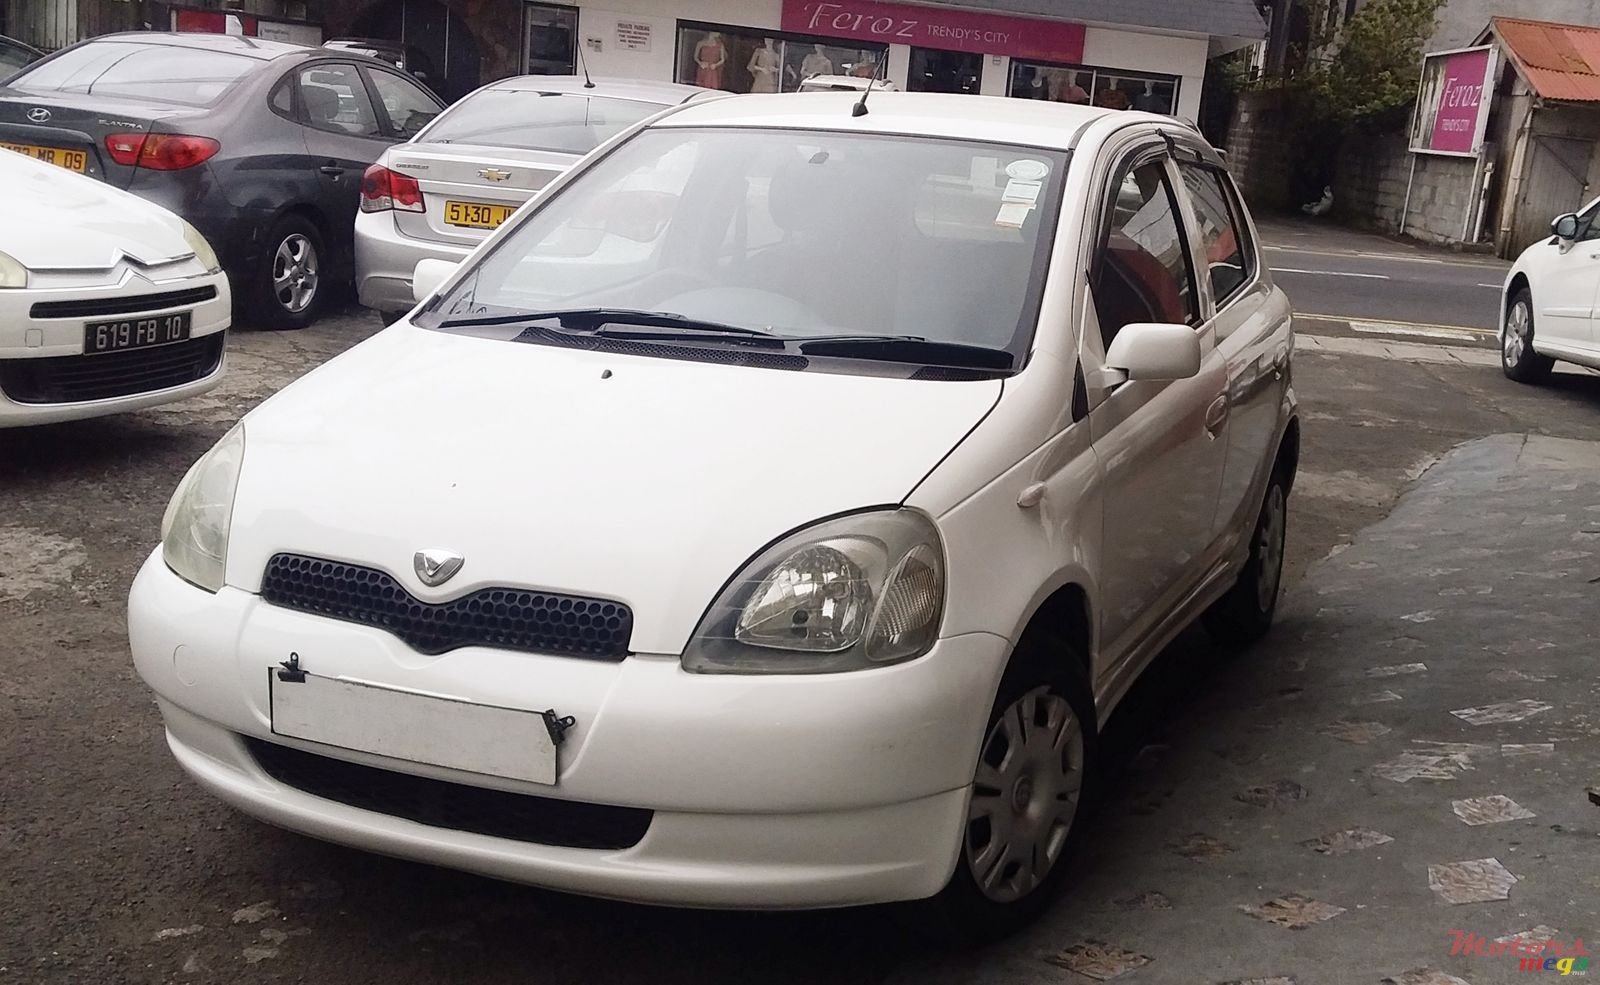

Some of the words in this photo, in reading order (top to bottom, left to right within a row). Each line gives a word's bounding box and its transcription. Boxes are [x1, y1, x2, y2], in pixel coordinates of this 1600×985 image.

[804, 3, 918, 37] Feroz
[927, 24, 981, 40] TRENDY'S
[984, 31, 1010, 44] CITY
[1440, 77, 1482, 111] Feroz
[64, 151, 83, 170] 09
[450, 204, 491, 224] 5130
[96, 323, 130, 350] 619
[136, 319, 157, 345] FB
[165, 316, 182, 341] 10
